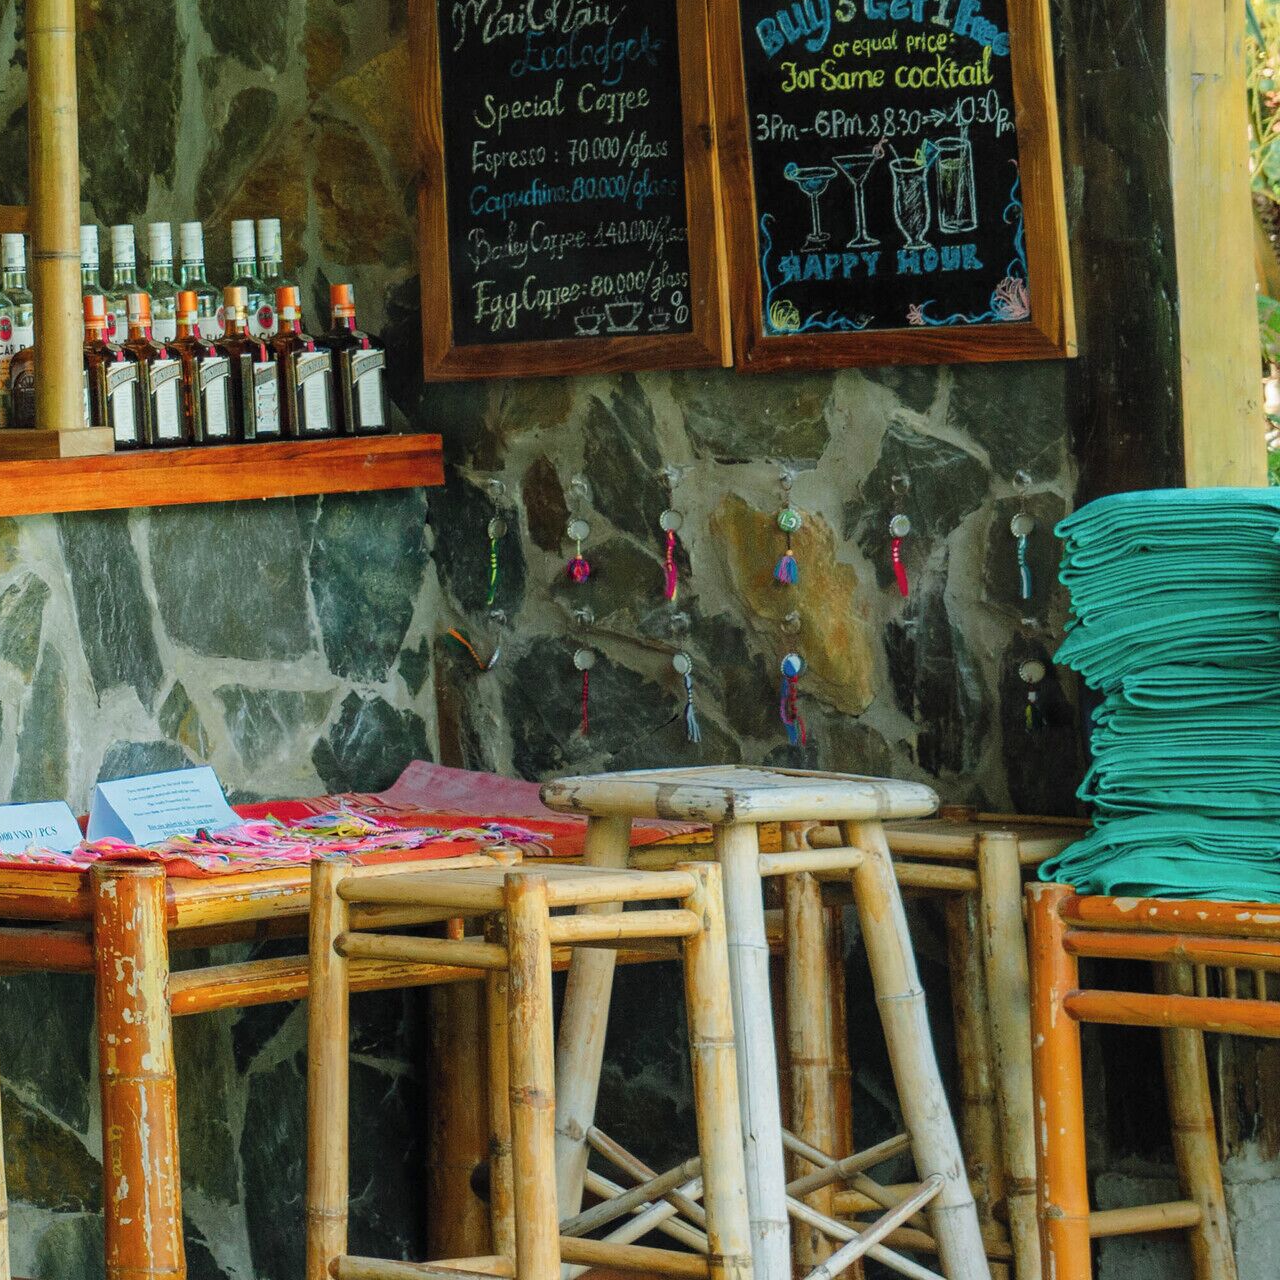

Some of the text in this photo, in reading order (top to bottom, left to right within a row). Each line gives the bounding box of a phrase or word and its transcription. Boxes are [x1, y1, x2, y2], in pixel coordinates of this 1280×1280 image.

[852, 28, 898, 57] equal
[473, 78, 565, 136] Special
[777, 243, 984, 281] HAPPY HOUR
[13, 829, 33, 839] VND
[38, 825, 58, 837] PCS
